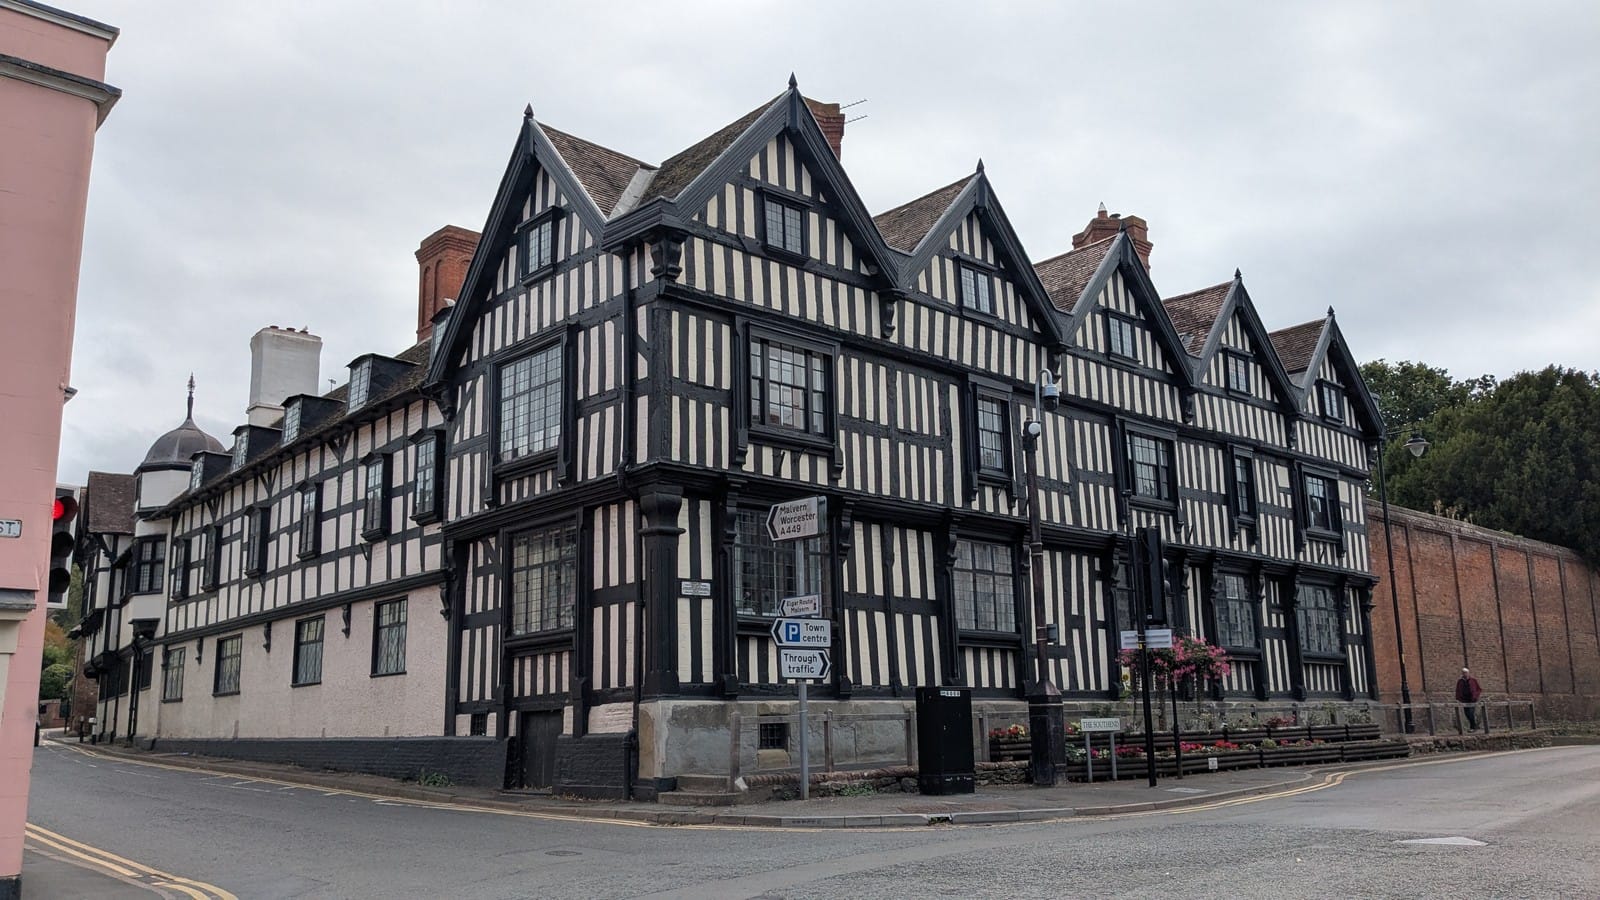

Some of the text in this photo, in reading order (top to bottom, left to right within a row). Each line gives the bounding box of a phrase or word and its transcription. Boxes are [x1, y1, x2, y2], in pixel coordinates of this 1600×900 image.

[780, 504, 808, 514] Malvern
[780, 513, 816, 525] Worcester
[780, 525, 801, 535] A449
[789, 625, 798, 640] P
[804, 623, 825, 632] Town
[802, 634, 828, 642] centre
[783, 653, 818, 665] Through
[788, 664, 815, 673] traffic
[1083, 720, 1119, 729] THE SOUTHEND
